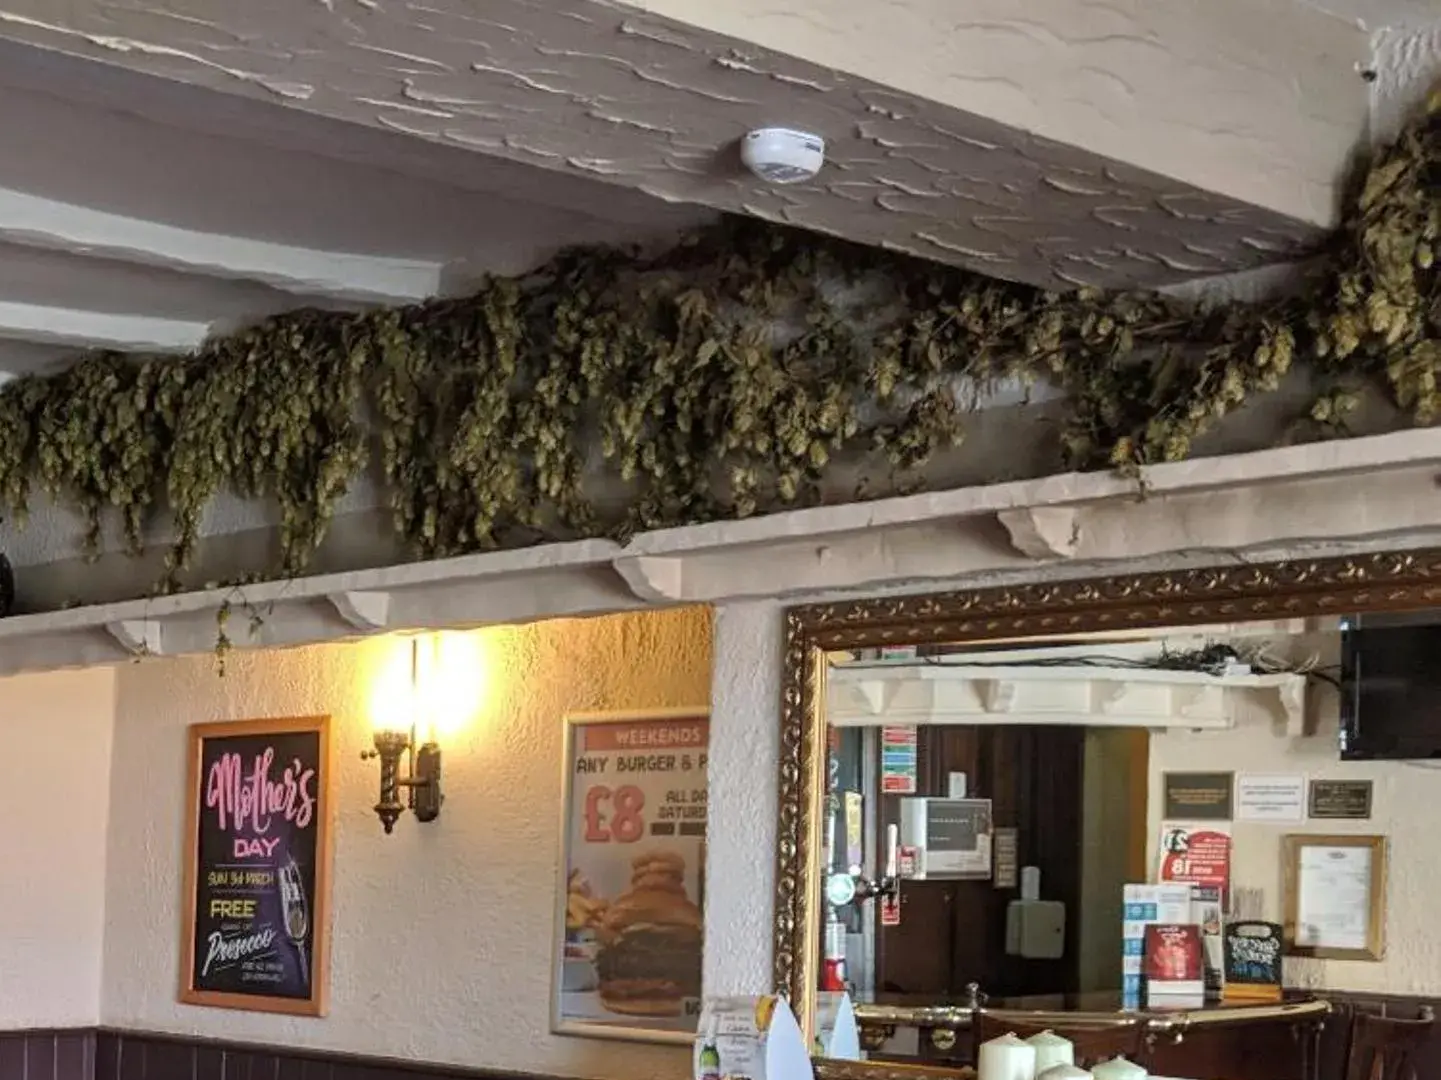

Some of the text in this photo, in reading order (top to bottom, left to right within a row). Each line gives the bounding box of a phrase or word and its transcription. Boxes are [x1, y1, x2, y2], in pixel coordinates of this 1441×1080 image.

[616, 727, 701, 745] WEEKENDS
[576, 757, 609, 774] ANY
[616, 754, 675, 772] BURGER
[206, 747, 315, 835] Mother's
[666, 789, 707, 804] ALL DA
[584, 785, 645, 844] £8
[658, 806, 707, 820] SATURD
[234, 836, 280, 857] DAY
[210, 900, 257, 919] FREE
[202, 928, 277, 976] Prosecco
